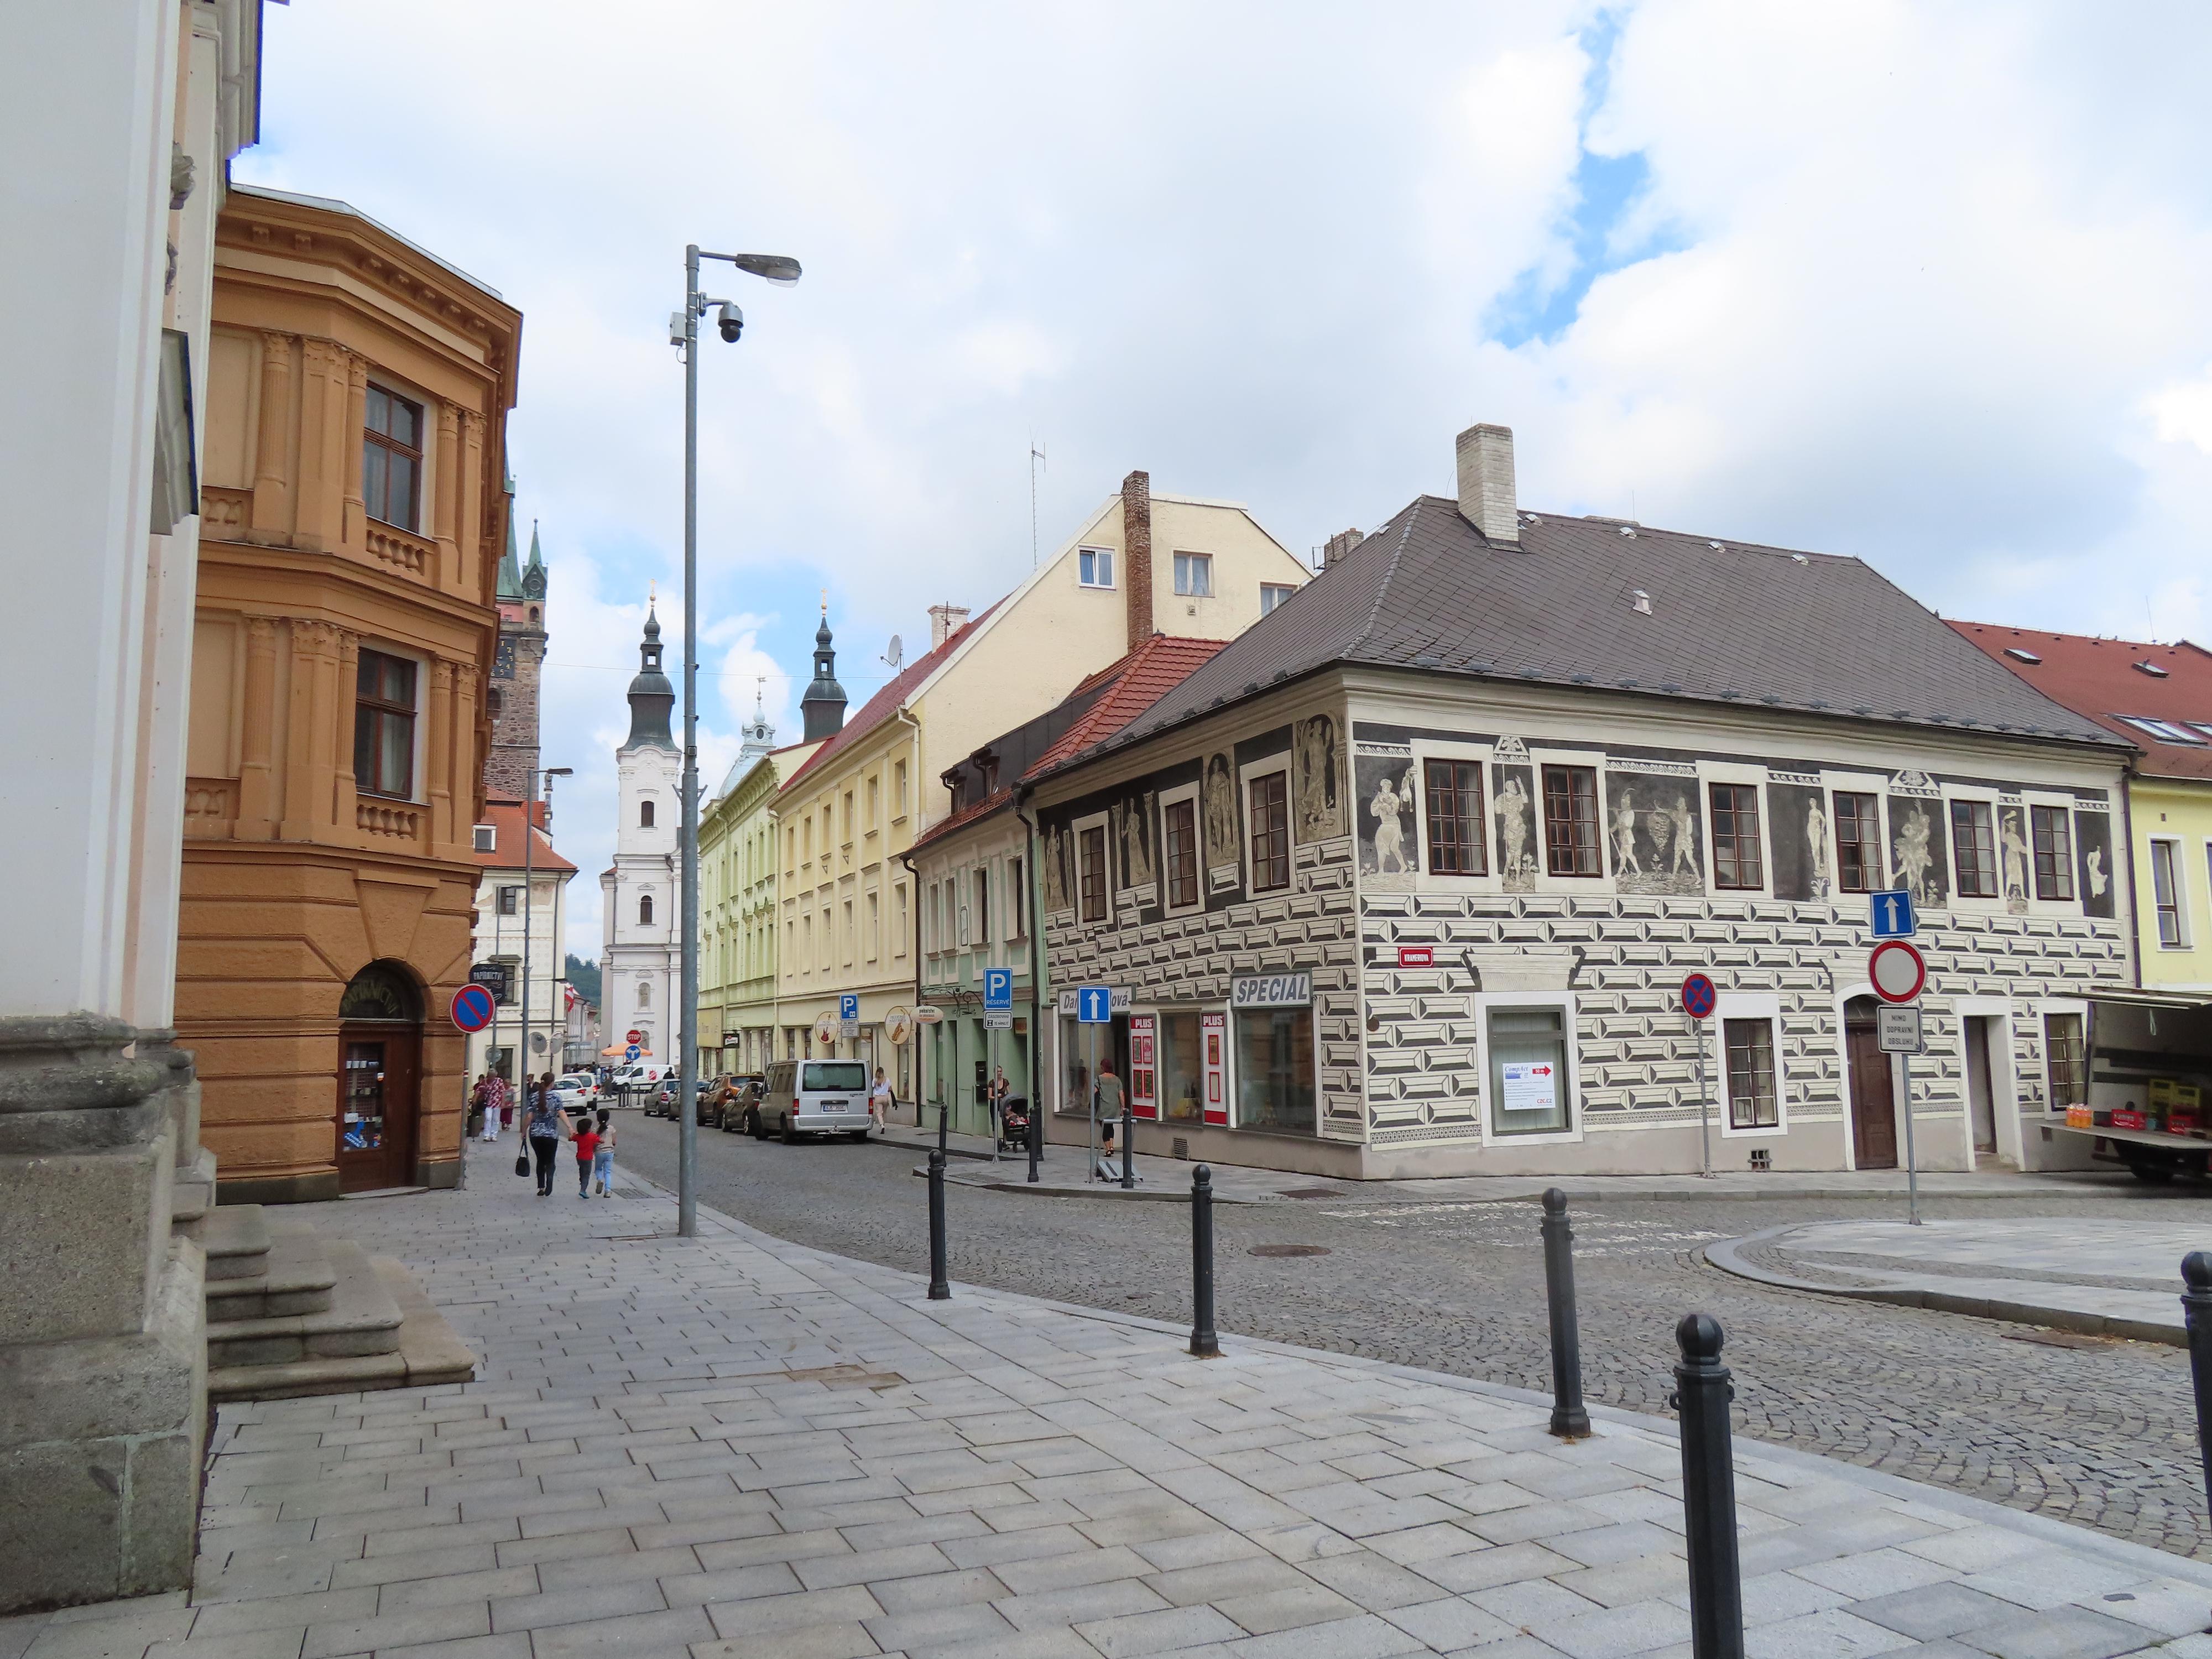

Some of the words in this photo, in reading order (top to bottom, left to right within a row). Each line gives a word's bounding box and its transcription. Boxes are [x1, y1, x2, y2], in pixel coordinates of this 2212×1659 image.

[990, 974, 1006, 997] P
[1237, 972, 1308, 1003] SPECIÁL
[843, 997, 854, 1013] P
[1135, 1019, 1153, 1028] PLUS
[1203, 1015, 1224, 1026] PLUS
